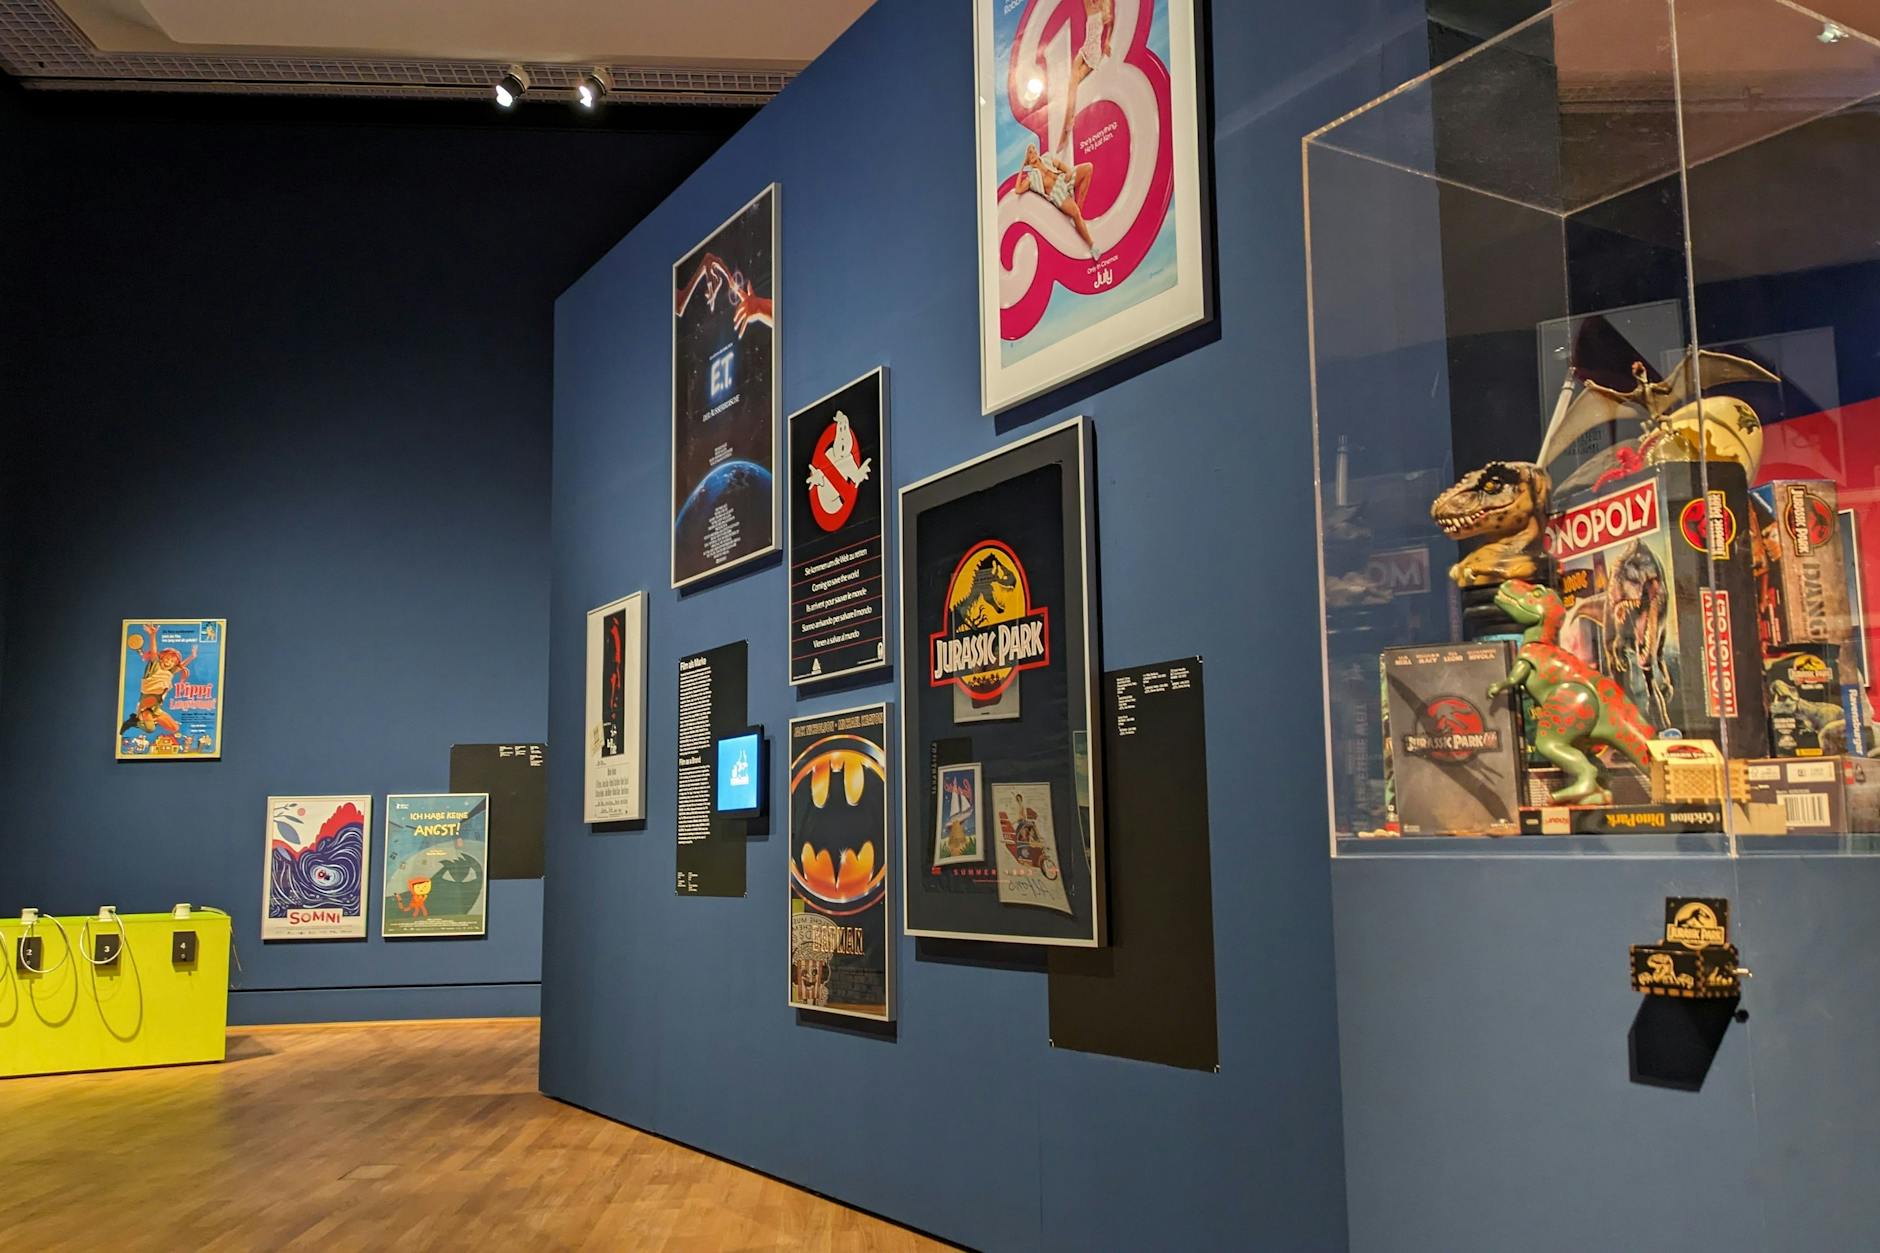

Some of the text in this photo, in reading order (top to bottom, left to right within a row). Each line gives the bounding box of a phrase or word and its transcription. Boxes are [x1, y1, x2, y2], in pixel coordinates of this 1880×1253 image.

[1093, 268, 1113, 288] July
[1546, 490, 1653, 553] ONOPOLY
[1791, 488, 1810, 554] JURASSIC PARK
[810, 561, 829, 574] kommen
[840, 553, 849, 563] Welt
[854, 548, 867, 559] retten
[811, 582, 828, 592] Coming
[832, 576, 840, 585] save
[840, 573, 848, 582] the
[847, 569, 860, 580] world
[825, 598, 835, 609] pour
[834, 594, 847, 604] sauver
[851, 587, 867, 598] monde
[832, 615, 840, 625] per
[857, 605, 872, 616] mondo
[844, 630, 860, 640] mundo
[934, 620, 1044, 679] JURASSIC PARK
[175, 682, 214, 699] Pippi
[1407, 735, 1453, 751] JURASSIC
[1453, 734, 1484, 749] PARK
[410, 811, 469, 820] ICH HABE KEINE
[1670, 811, 1716, 824] Crichton
[414, 822, 461, 836] ANGST!
[290, 911, 340, 925] SOMNI
[812, 925, 865, 955] BATMAN
